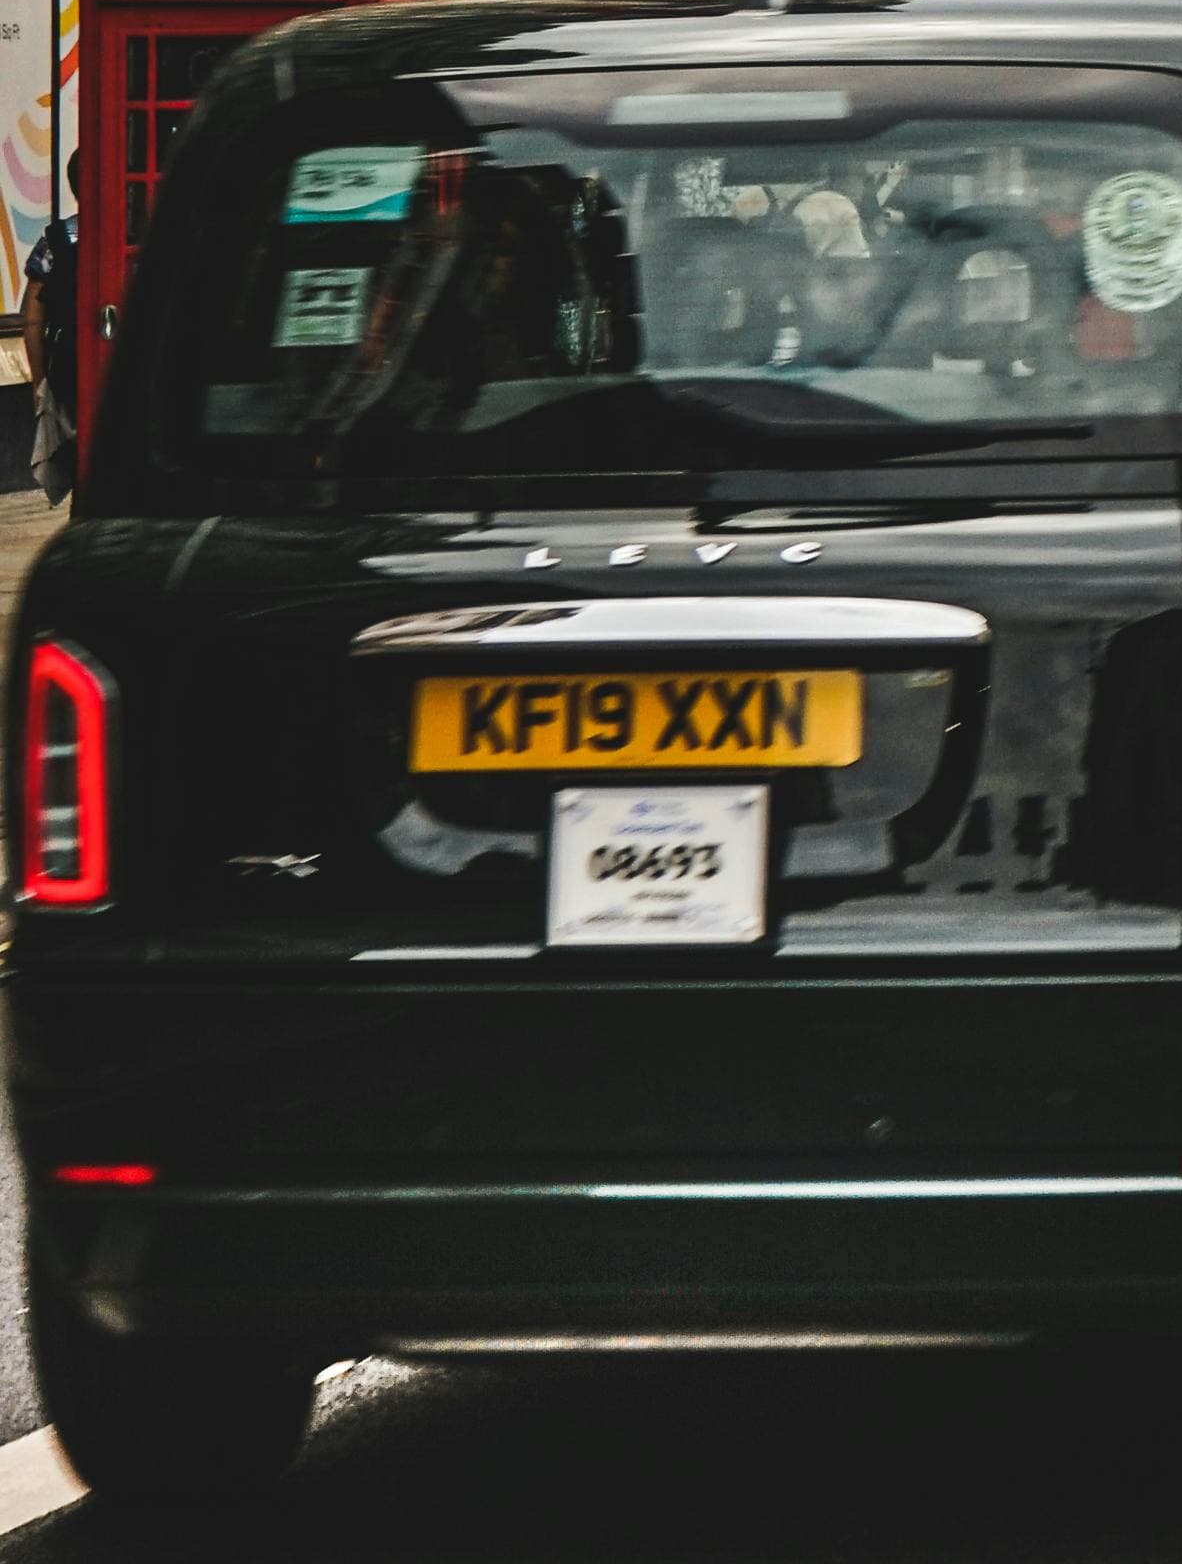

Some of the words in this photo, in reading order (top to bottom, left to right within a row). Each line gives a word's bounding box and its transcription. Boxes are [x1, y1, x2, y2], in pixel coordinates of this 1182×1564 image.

[523, 541, 823, 569] LEVC
[459, 680, 637, 755] KF19
[653, 677, 808, 752] XXN
